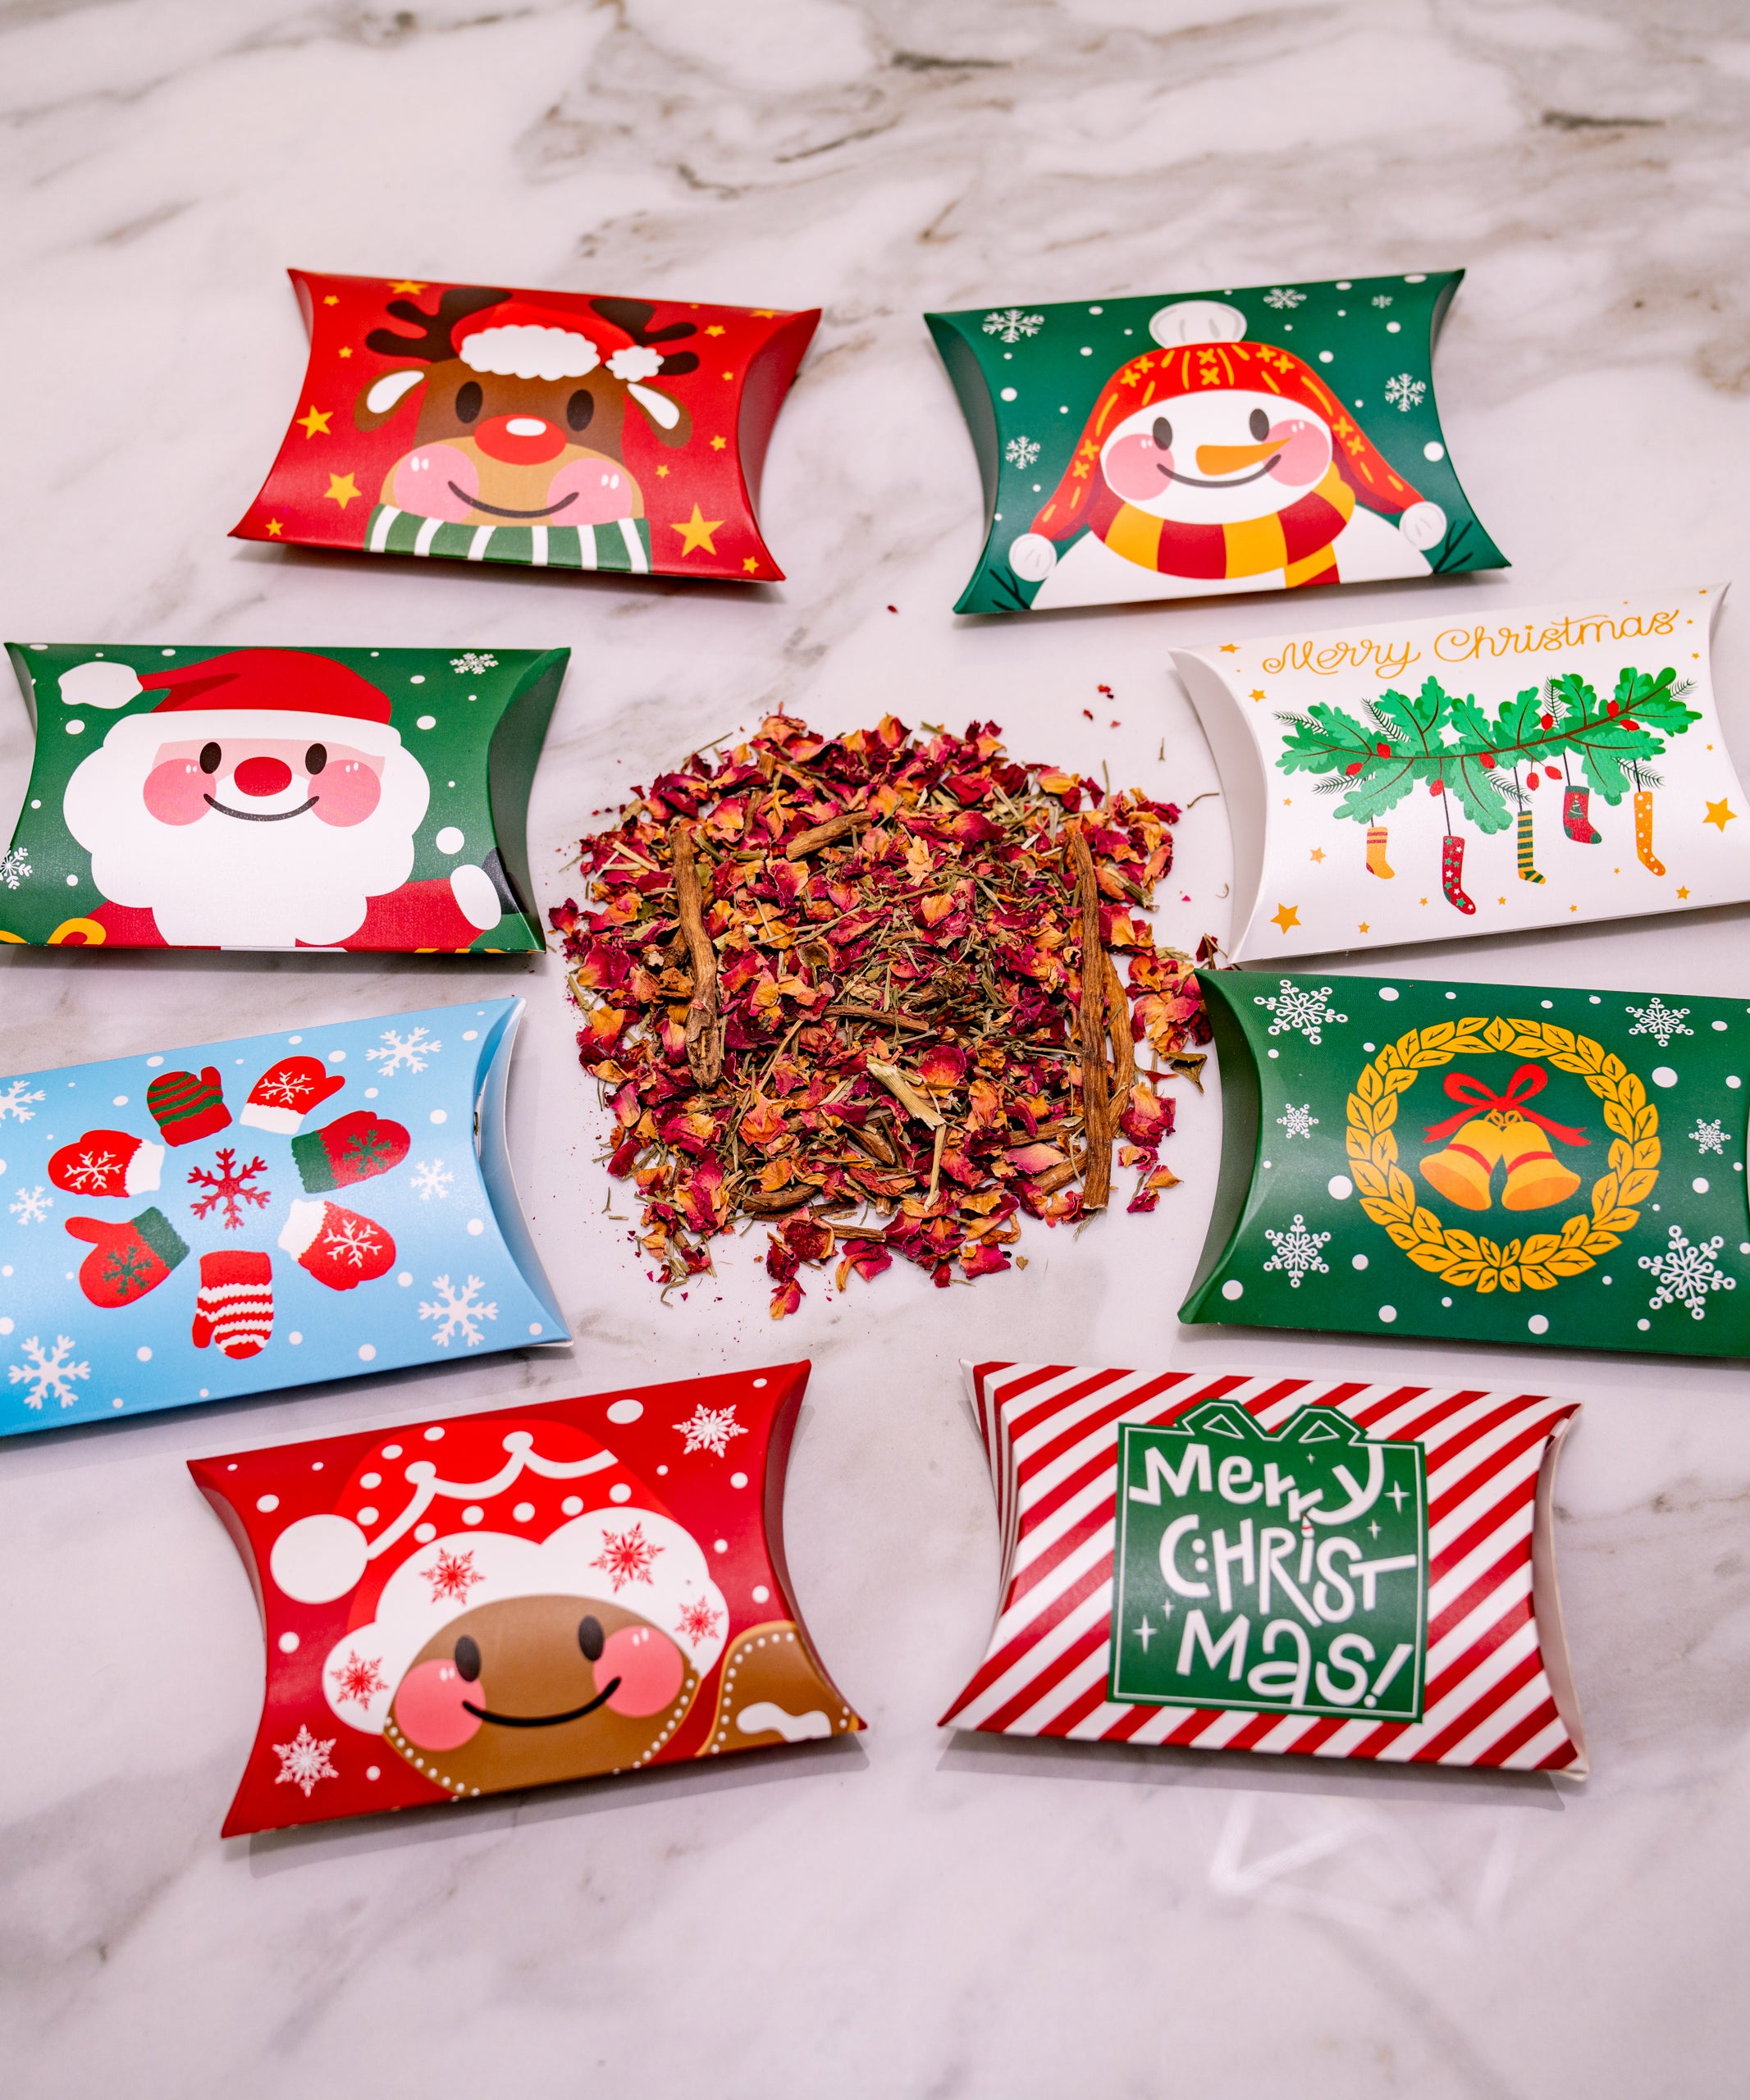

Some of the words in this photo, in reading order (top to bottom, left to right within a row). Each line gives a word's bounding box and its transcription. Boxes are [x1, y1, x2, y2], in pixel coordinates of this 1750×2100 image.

[1262, 639, 1420, 678] Merry
[1433, 610, 1679, 662] Christmas
[1129, 1443, 1384, 1525] Merry
